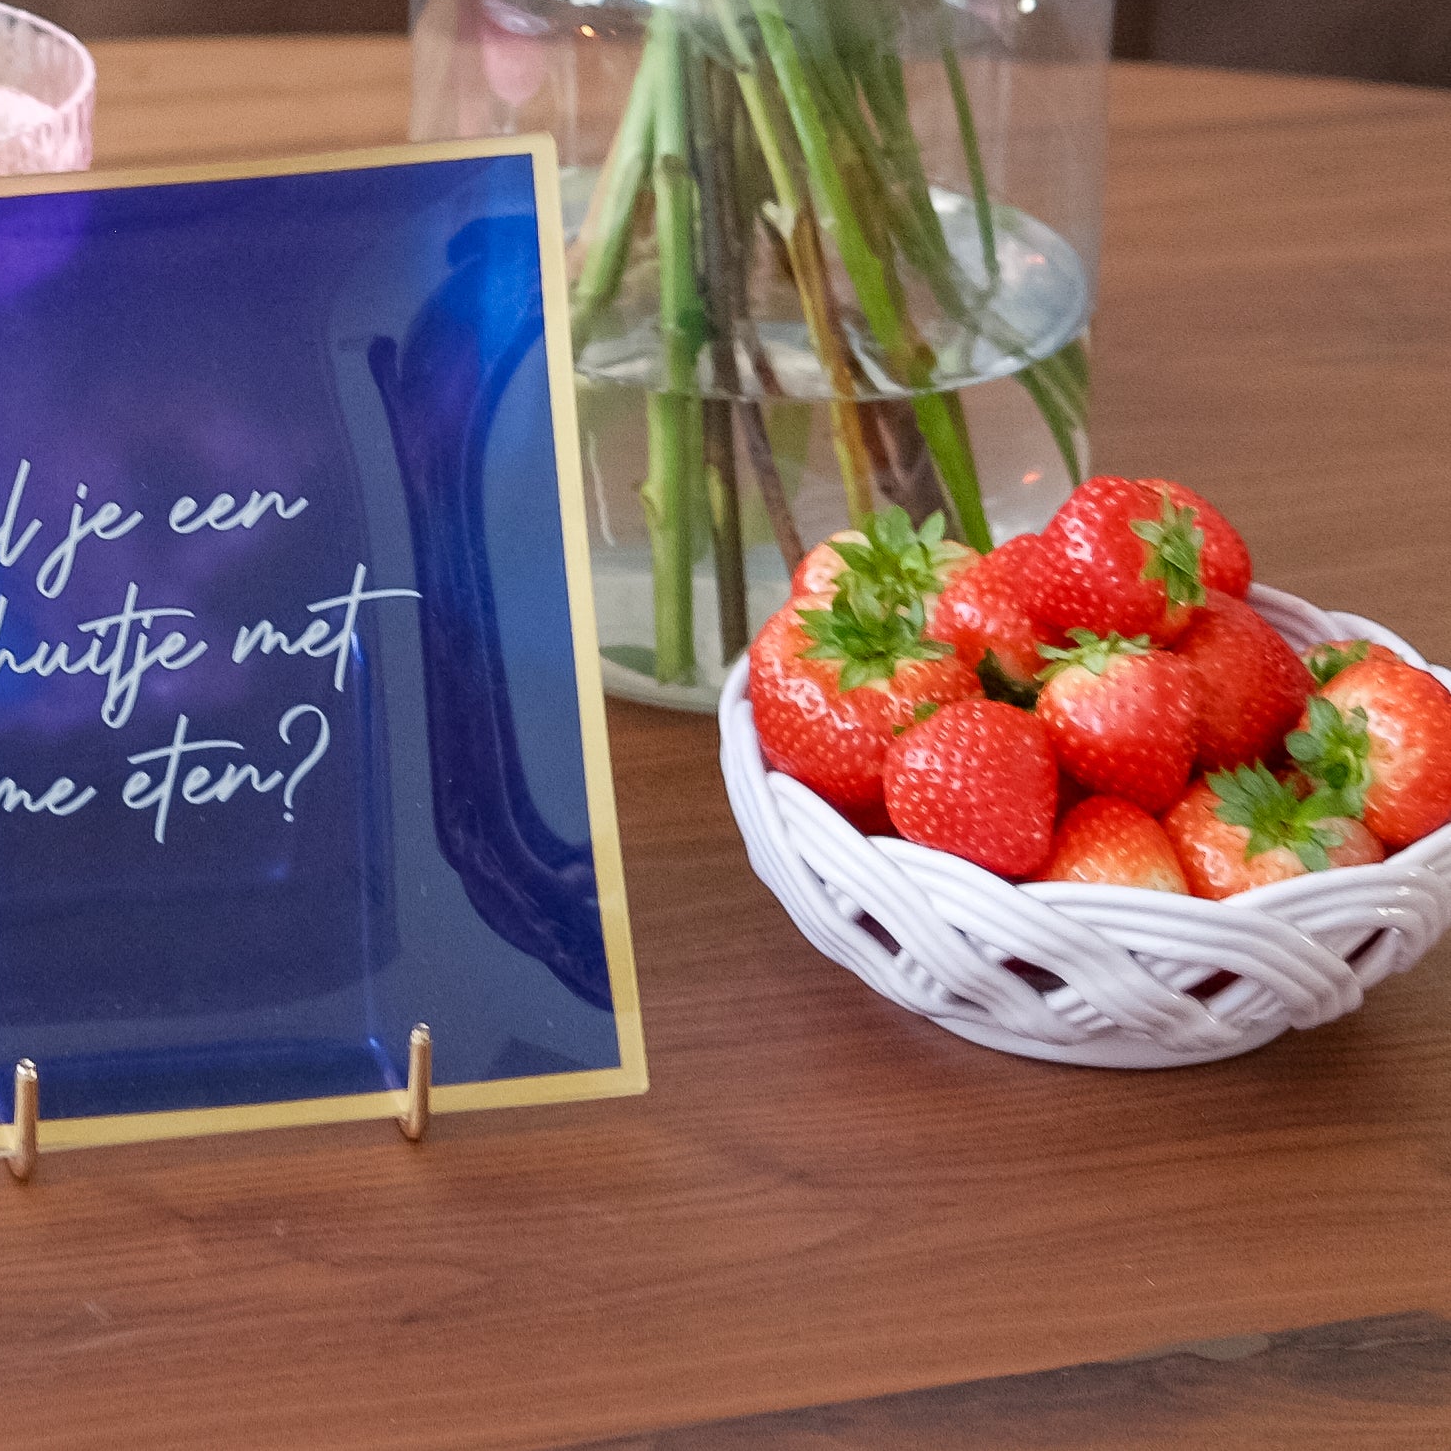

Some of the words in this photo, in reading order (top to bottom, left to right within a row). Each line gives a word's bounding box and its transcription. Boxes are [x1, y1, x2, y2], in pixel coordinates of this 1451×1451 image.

[36, 482, 144, 598] je
[168, 489, 309, 535] een
[232, 563, 423, 692] met
[122, 703, 331, 844] eten?
